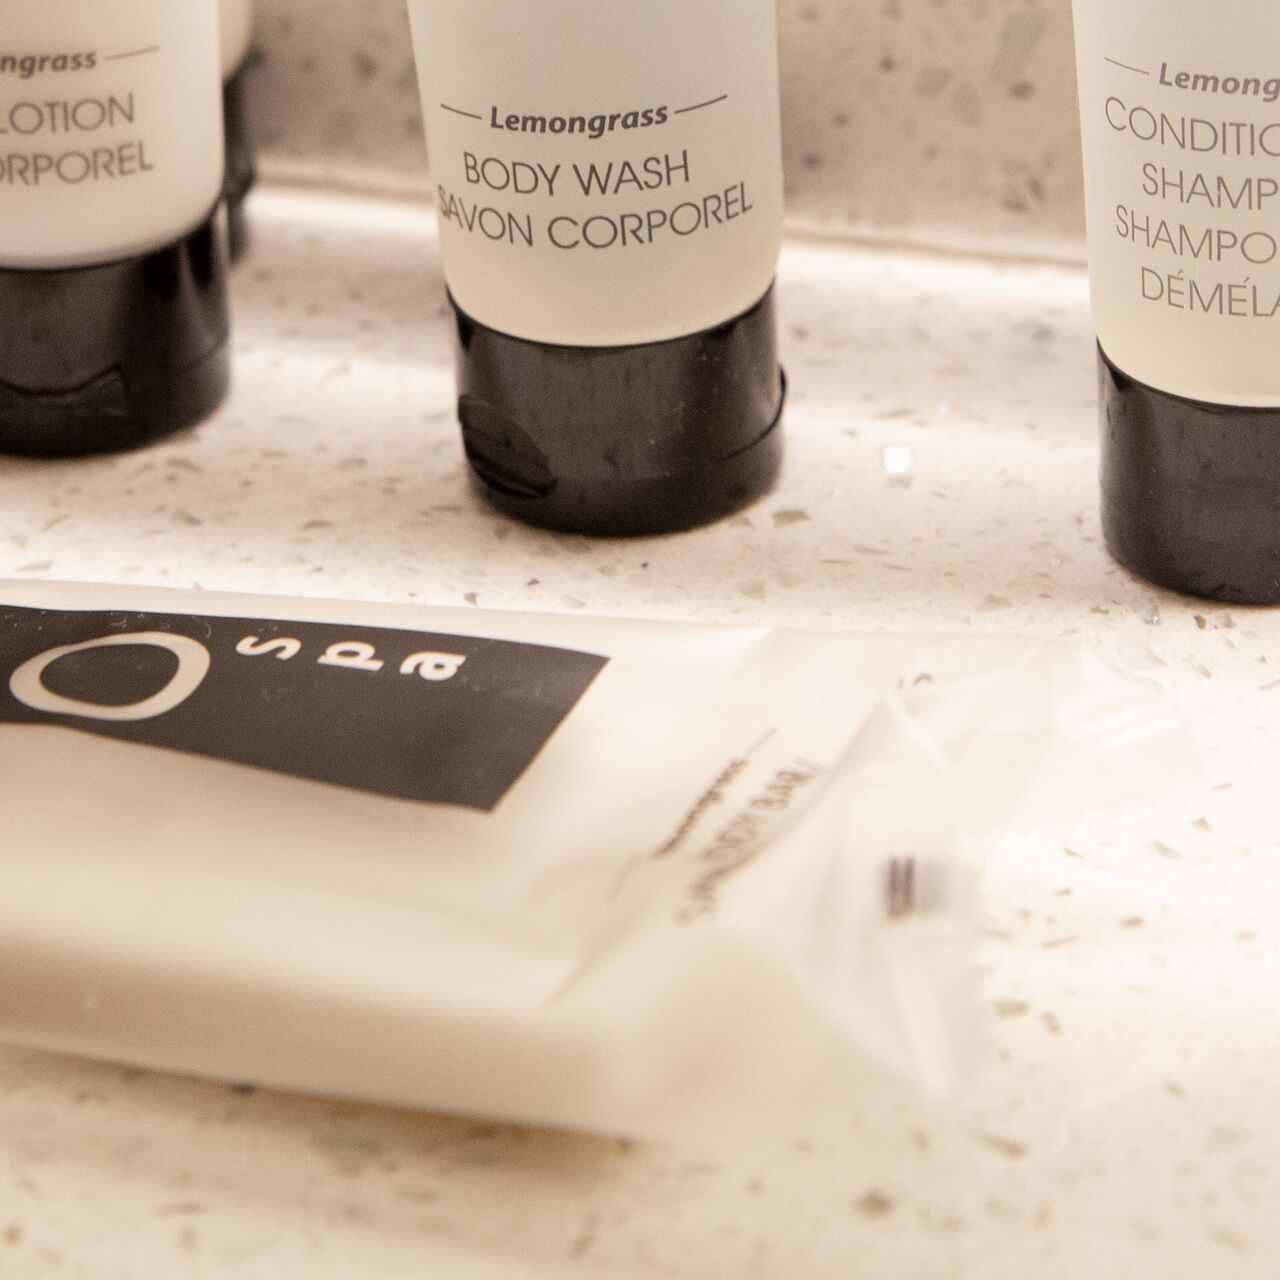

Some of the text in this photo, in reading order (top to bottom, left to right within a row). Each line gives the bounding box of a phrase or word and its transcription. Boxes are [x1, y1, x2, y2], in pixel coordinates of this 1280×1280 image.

[489, 105, 669, 139] Lemongrass
[463, 149, 690, 197] BODY WASH
[437, 181, 754, 249] SAVON CORPOREL
[235, 636, 467, 682] spa
